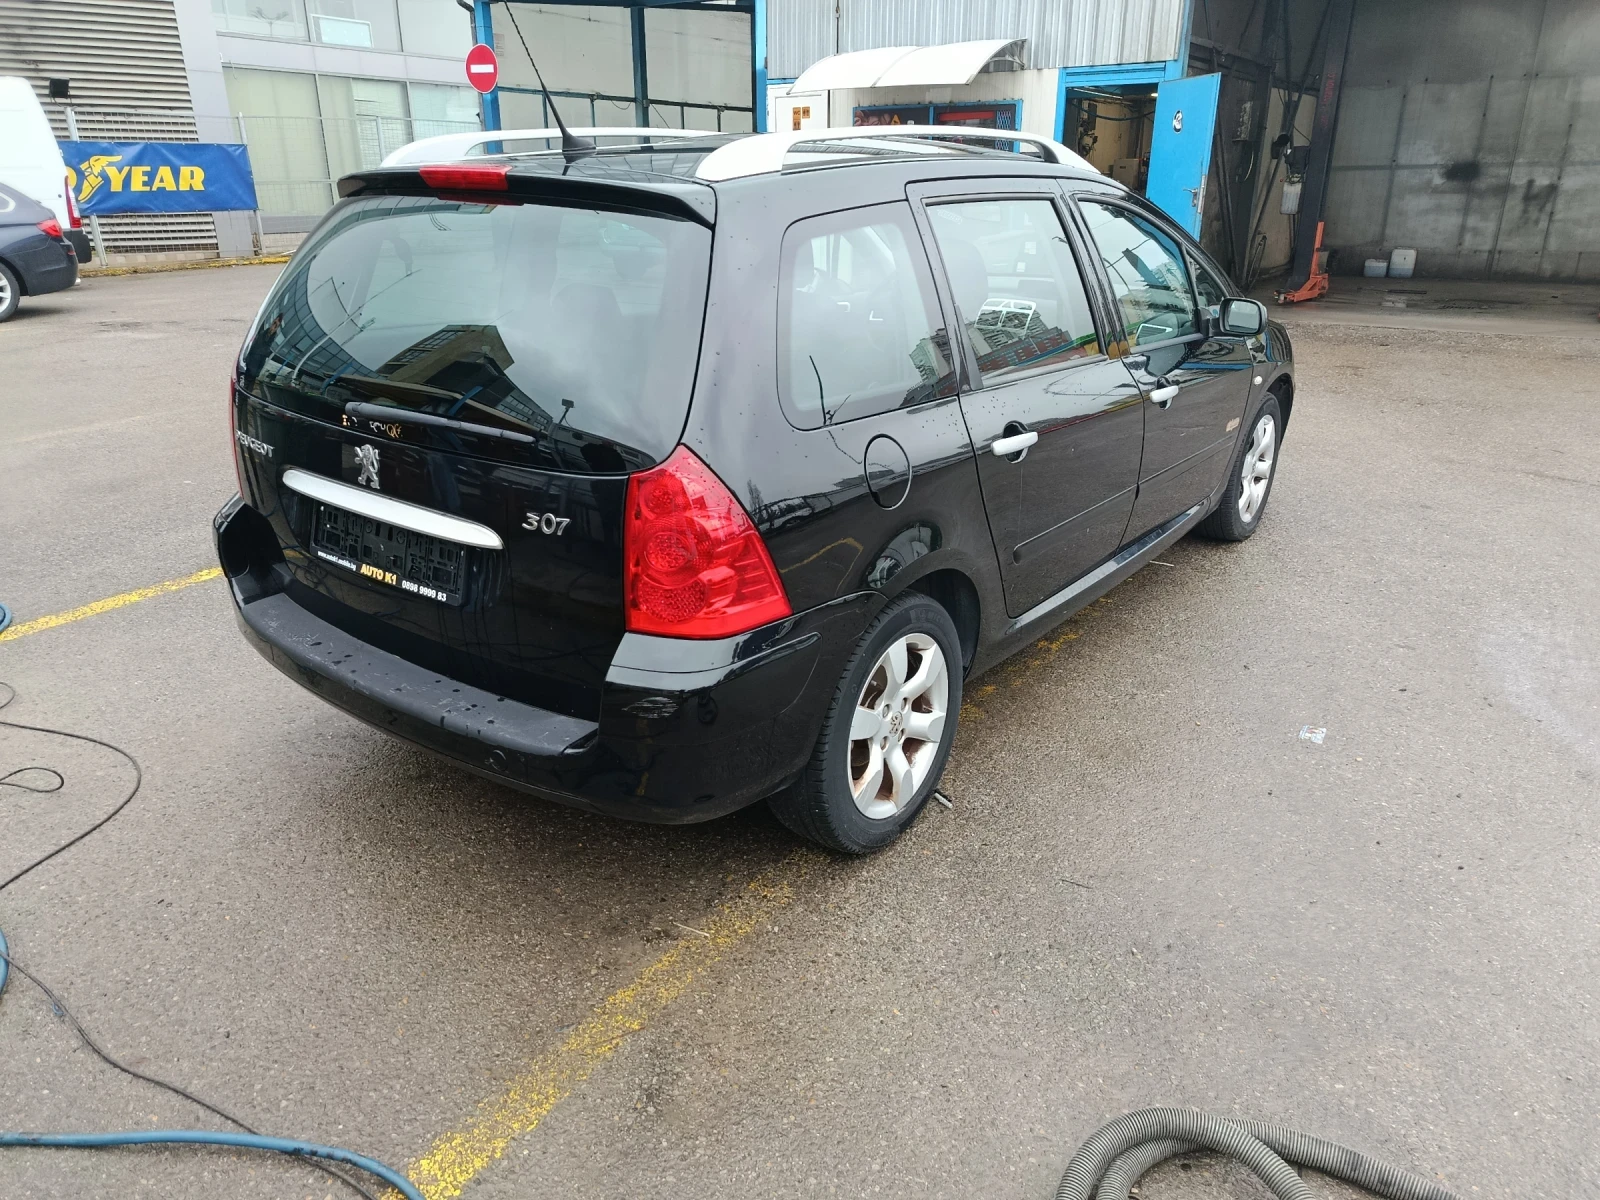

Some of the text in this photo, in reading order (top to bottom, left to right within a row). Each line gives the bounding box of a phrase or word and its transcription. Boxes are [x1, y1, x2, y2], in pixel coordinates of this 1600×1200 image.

[235, 429, 275, 458] PEUGEOT
[521, 512, 571, 536] 307
[360, 563, 397, 585] AUTO K1
[401, 580, 447, 601] 0898 9999 83
